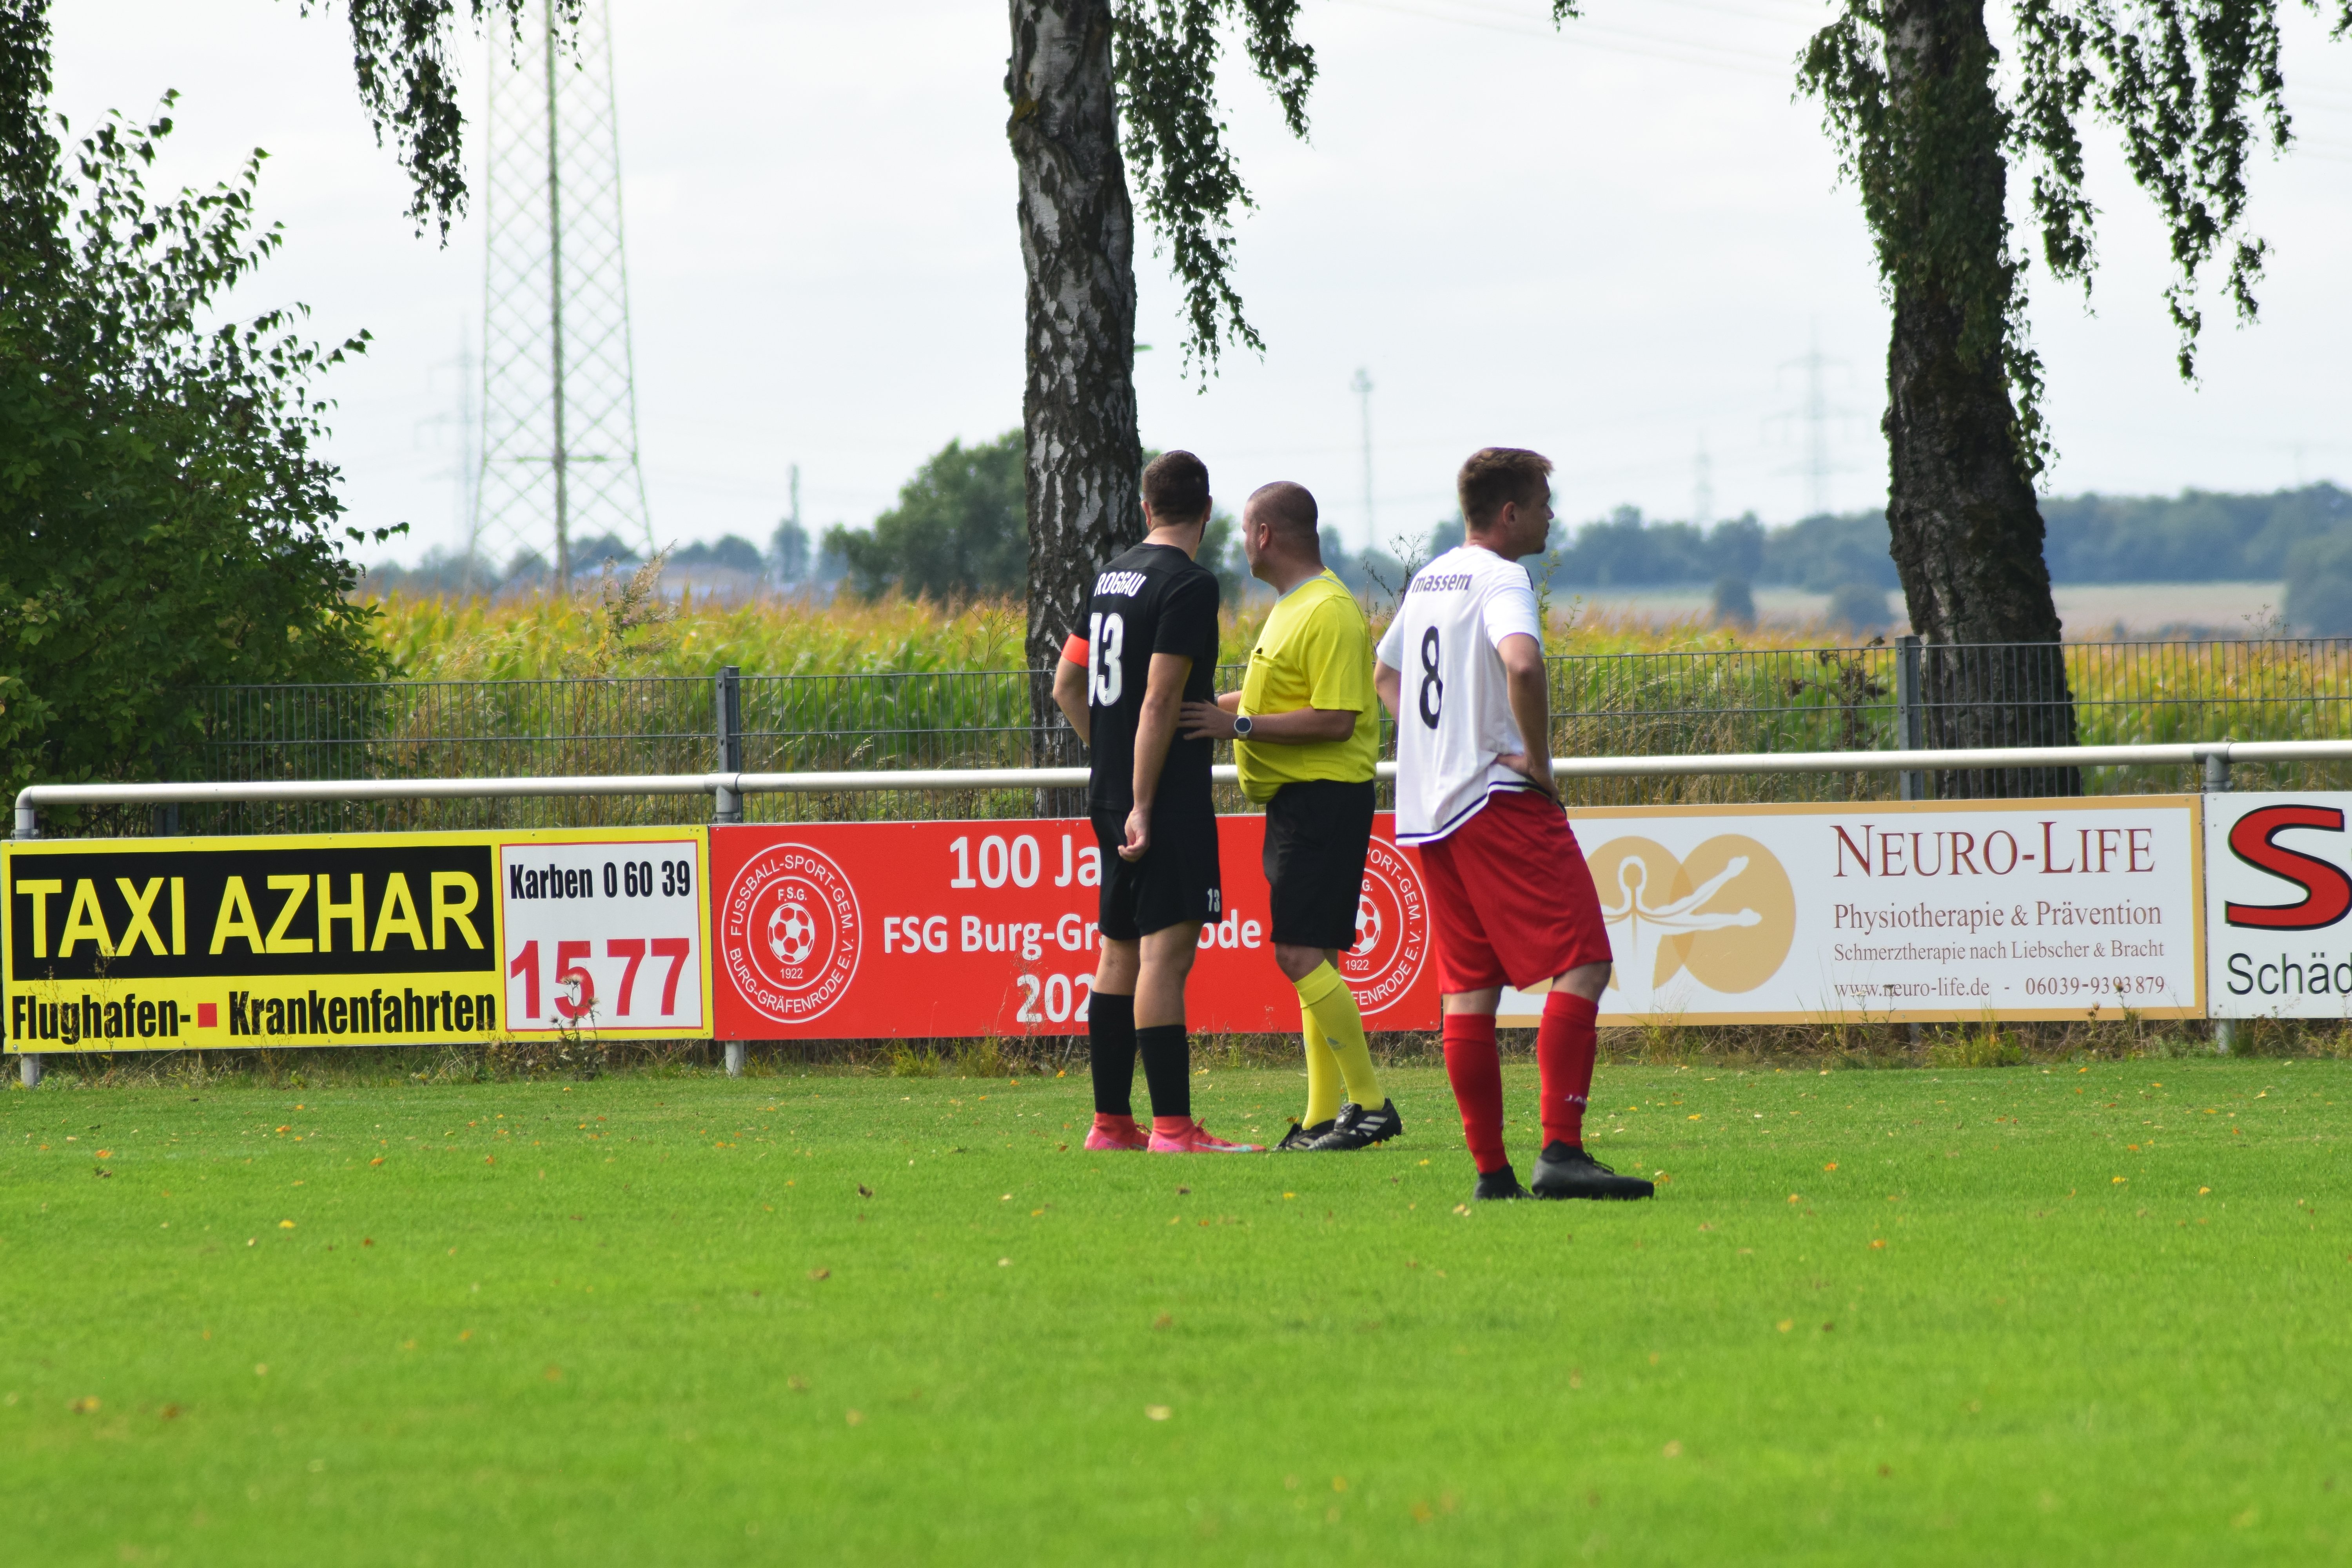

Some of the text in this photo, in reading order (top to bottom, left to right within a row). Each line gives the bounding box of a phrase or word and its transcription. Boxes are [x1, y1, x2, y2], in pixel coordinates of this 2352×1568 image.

[1094, 572, 1147, 597] ROGGAU
[1088, 612, 1123, 706] 13
[1419, 626, 1443, 730] 8
[950, 835, 1040, 888] 100
[1830, 822, 2155, 877] NEURO-LIFE
[2225, 804, 2352, 931] S
[510, 860, 690, 899] Karben 0 60 39
[1207, 888, 1220, 913] 13
[16, 871, 484, 958] TAXI AZHAR
[884, 916, 947, 953] FSG
[1834, 899, 2161, 935] Physiotherapie & Prävention
[1345, 959, 1369, 971] 1922
[1835, 939, 2164, 965] Schmerztherapie nach Liebscher & Bracht
[780, 968, 803, 979] 1922
[2227, 953, 2352, 995] Schäd
[12, 988, 496, 1045] Flughafen- Krankenfahrten
[1016, 974, 1096, 1023] 202
